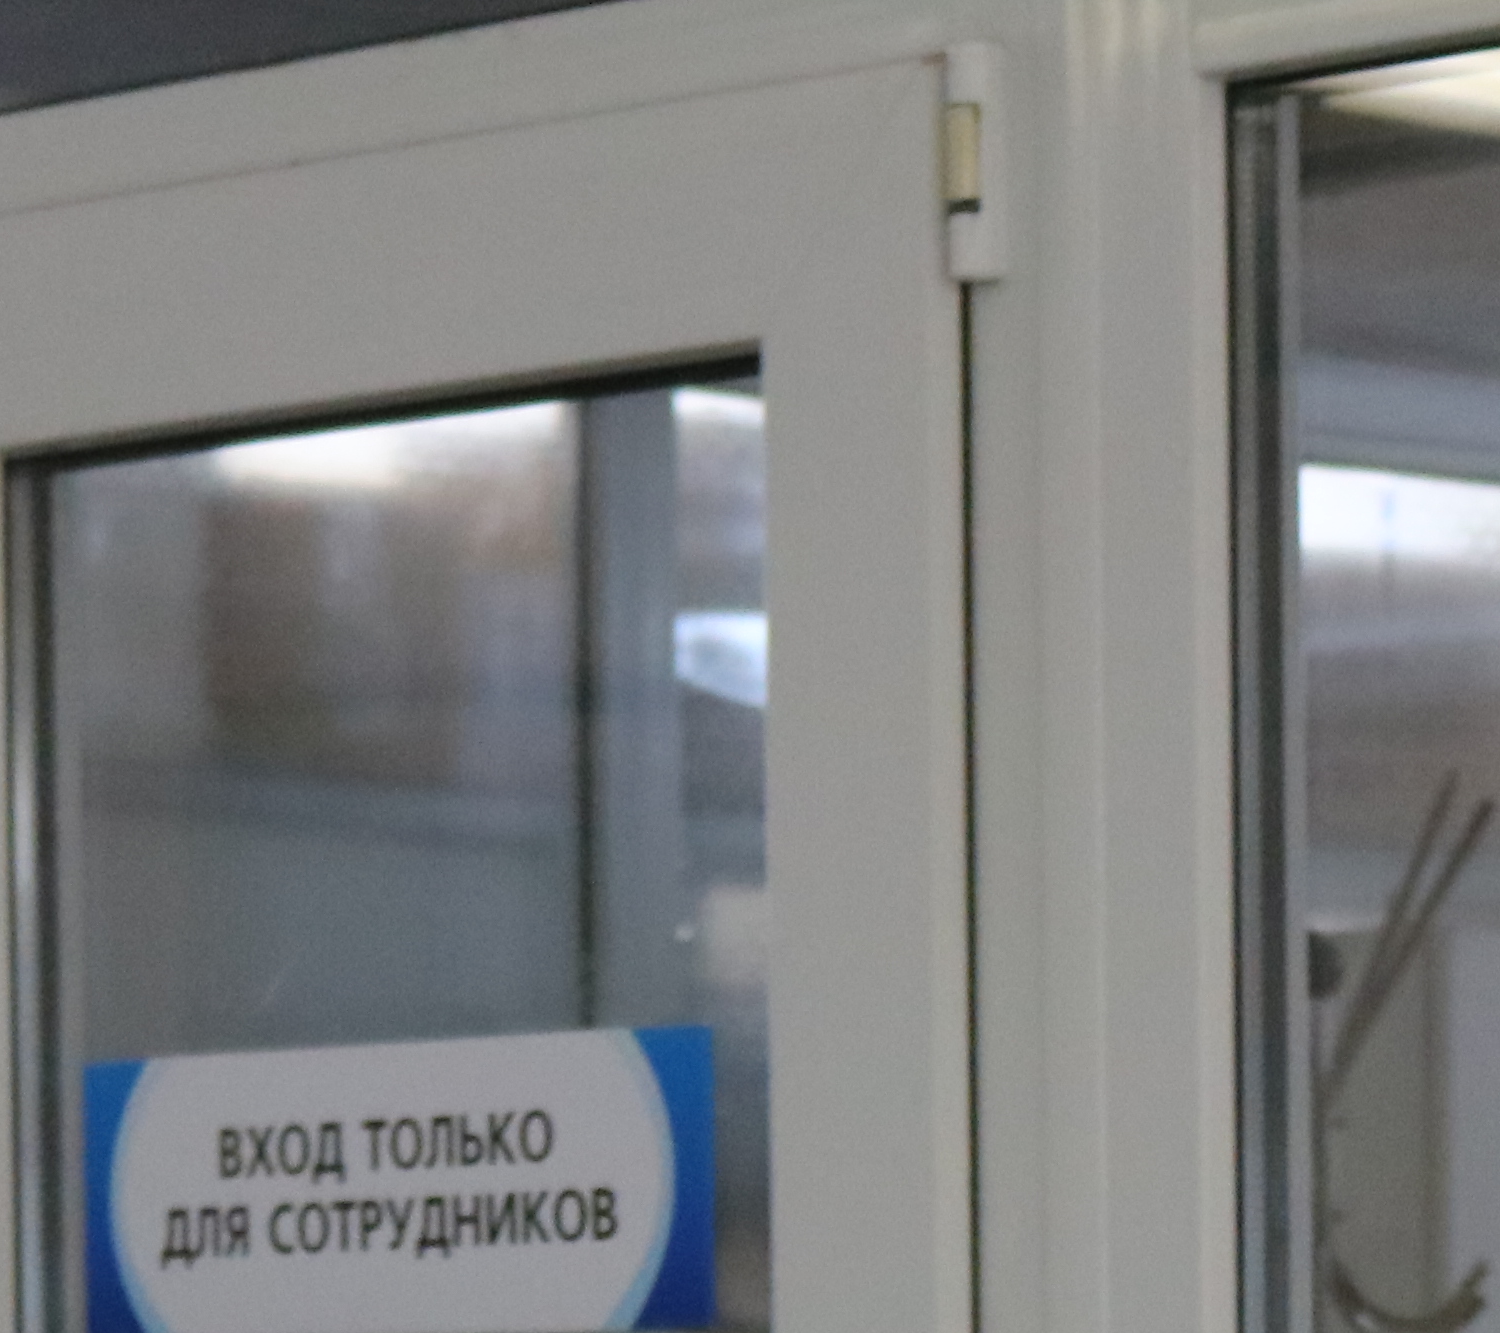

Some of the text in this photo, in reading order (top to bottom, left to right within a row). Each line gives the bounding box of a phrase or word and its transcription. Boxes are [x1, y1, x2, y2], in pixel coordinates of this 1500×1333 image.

[217, 1108, 555, 1182] ВХОД ТОЛЬКО
[160, 1185, 621, 1266] ДЛЯ СОТРУДНИКОВ
